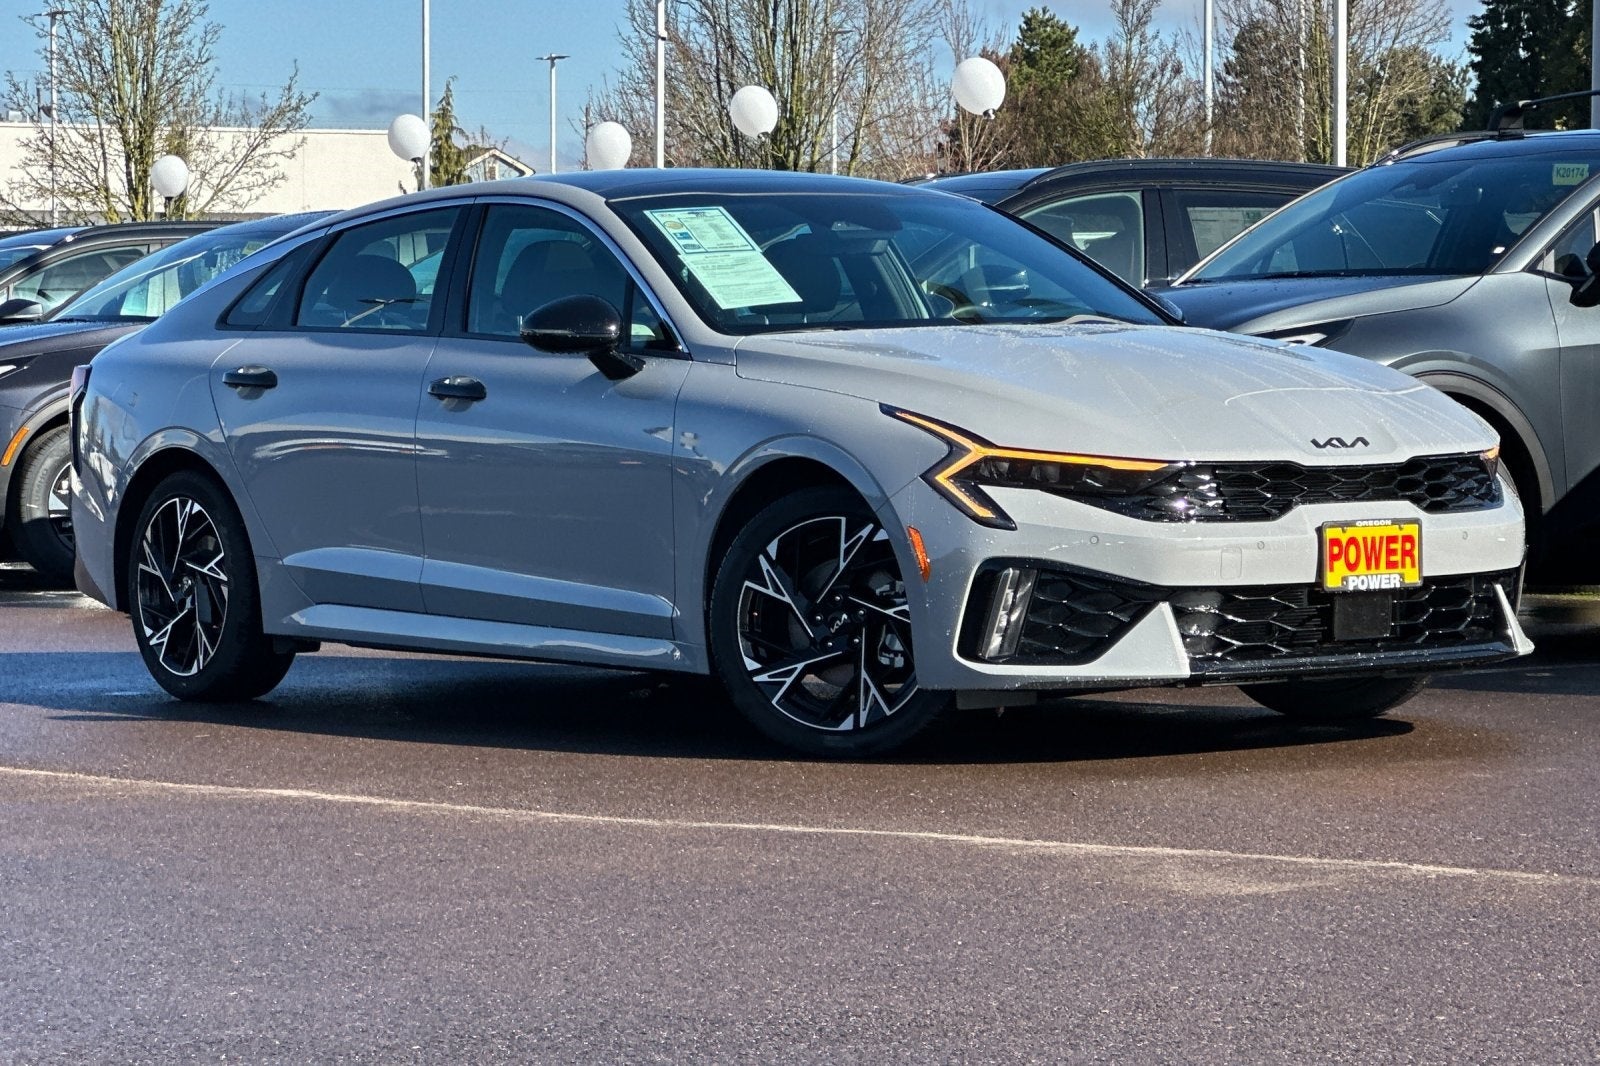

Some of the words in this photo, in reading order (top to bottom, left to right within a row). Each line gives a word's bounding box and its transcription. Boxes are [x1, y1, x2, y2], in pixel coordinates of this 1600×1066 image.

[1310, 437, 1370, 449] KIA
[1328, 535, 1416, 572] POWER
[1348, 574, 1400, 590] POWER
